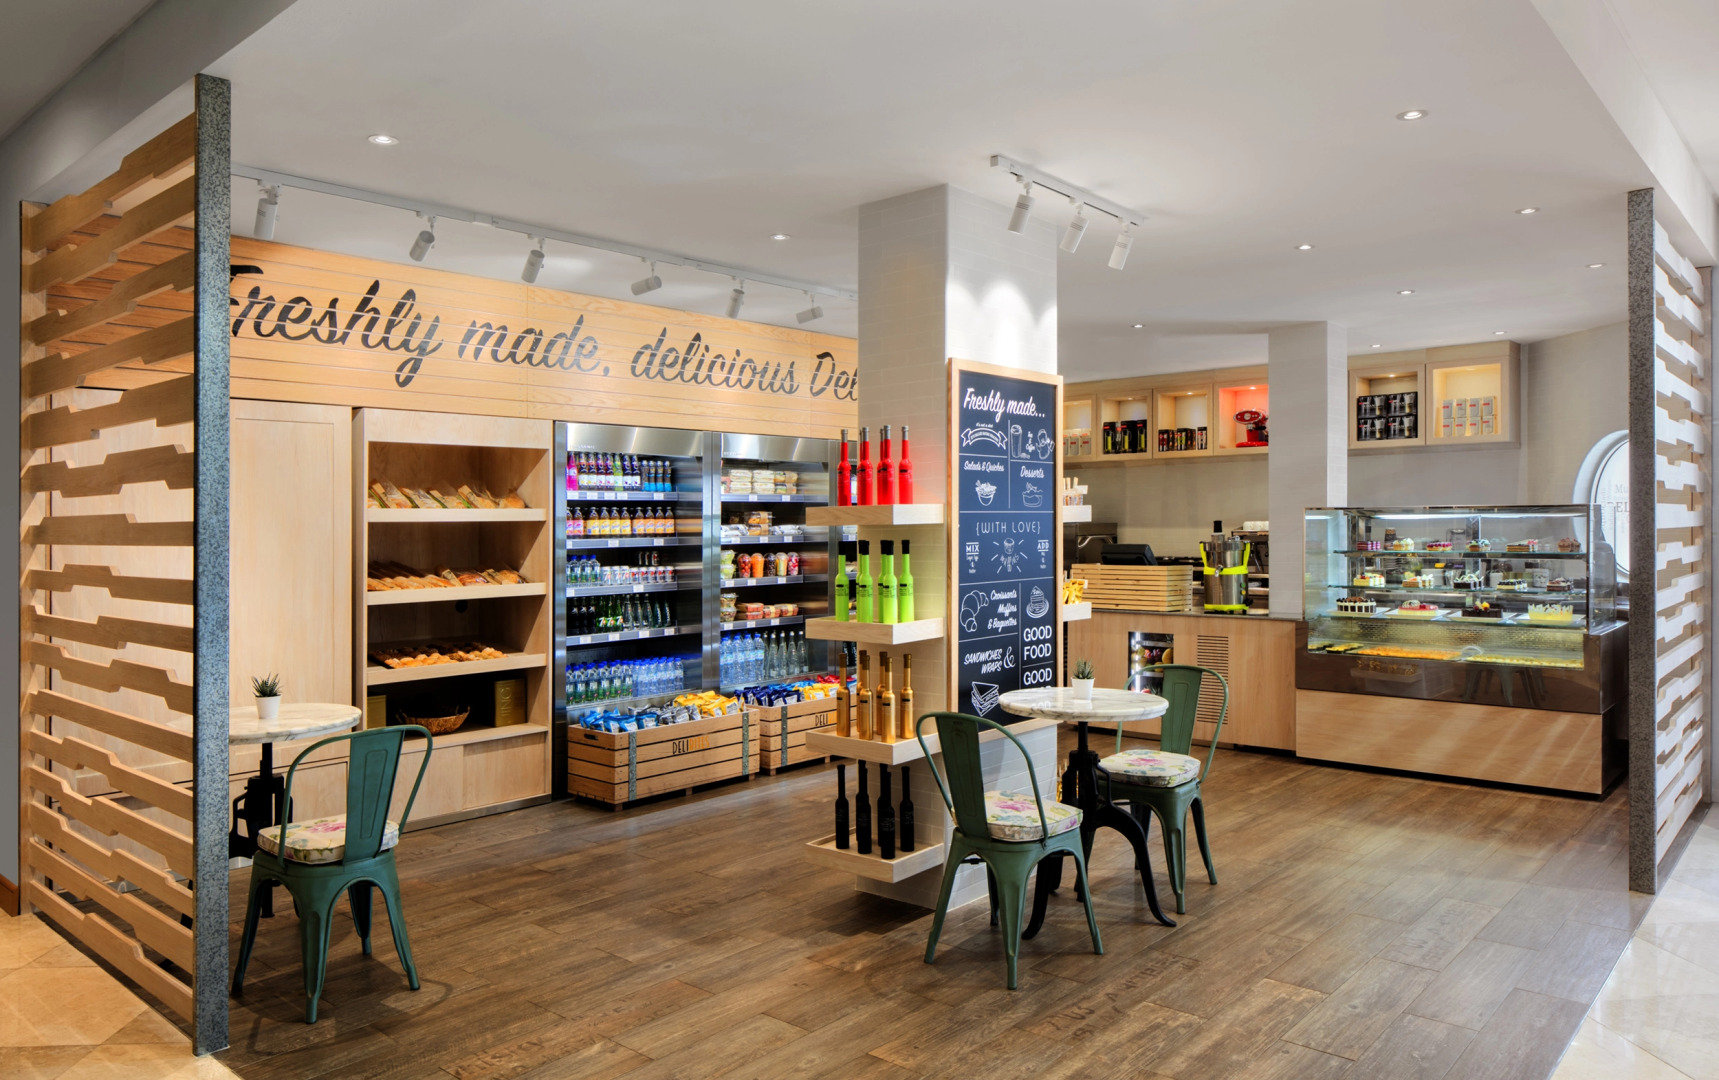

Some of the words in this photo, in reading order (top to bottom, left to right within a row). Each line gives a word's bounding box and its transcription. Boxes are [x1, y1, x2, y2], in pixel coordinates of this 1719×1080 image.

[457, 314, 612, 378] made,
[631, 326, 801, 396] delicious
[963, 387, 1006, 423] Freshly
[1006, 395, 1046, 418] made...
[963, 460, 981, 471] Salads
[985, 461, 1005, 473] Quiches
[1020, 465, 1045, 479] Desserts
[965, 543, 980, 553] MIX
[1037, 541, 1050, 550] ADD
[990, 589, 1018, 601] Croissants
[997, 603, 1018, 617] Muffins
[987, 618, 993, 630] &
[992, 617, 1018, 633] Baguettes
[1023, 625, 1052, 642] GOOD
[964, 648, 1003, 666] SANDWICHES
[1003, 646, 1017, 669] &
[1023, 643, 1052, 661] FOOD
[981, 660, 1003, 675] WRAPS
[1023, 667, 1052, 686] GOOD
